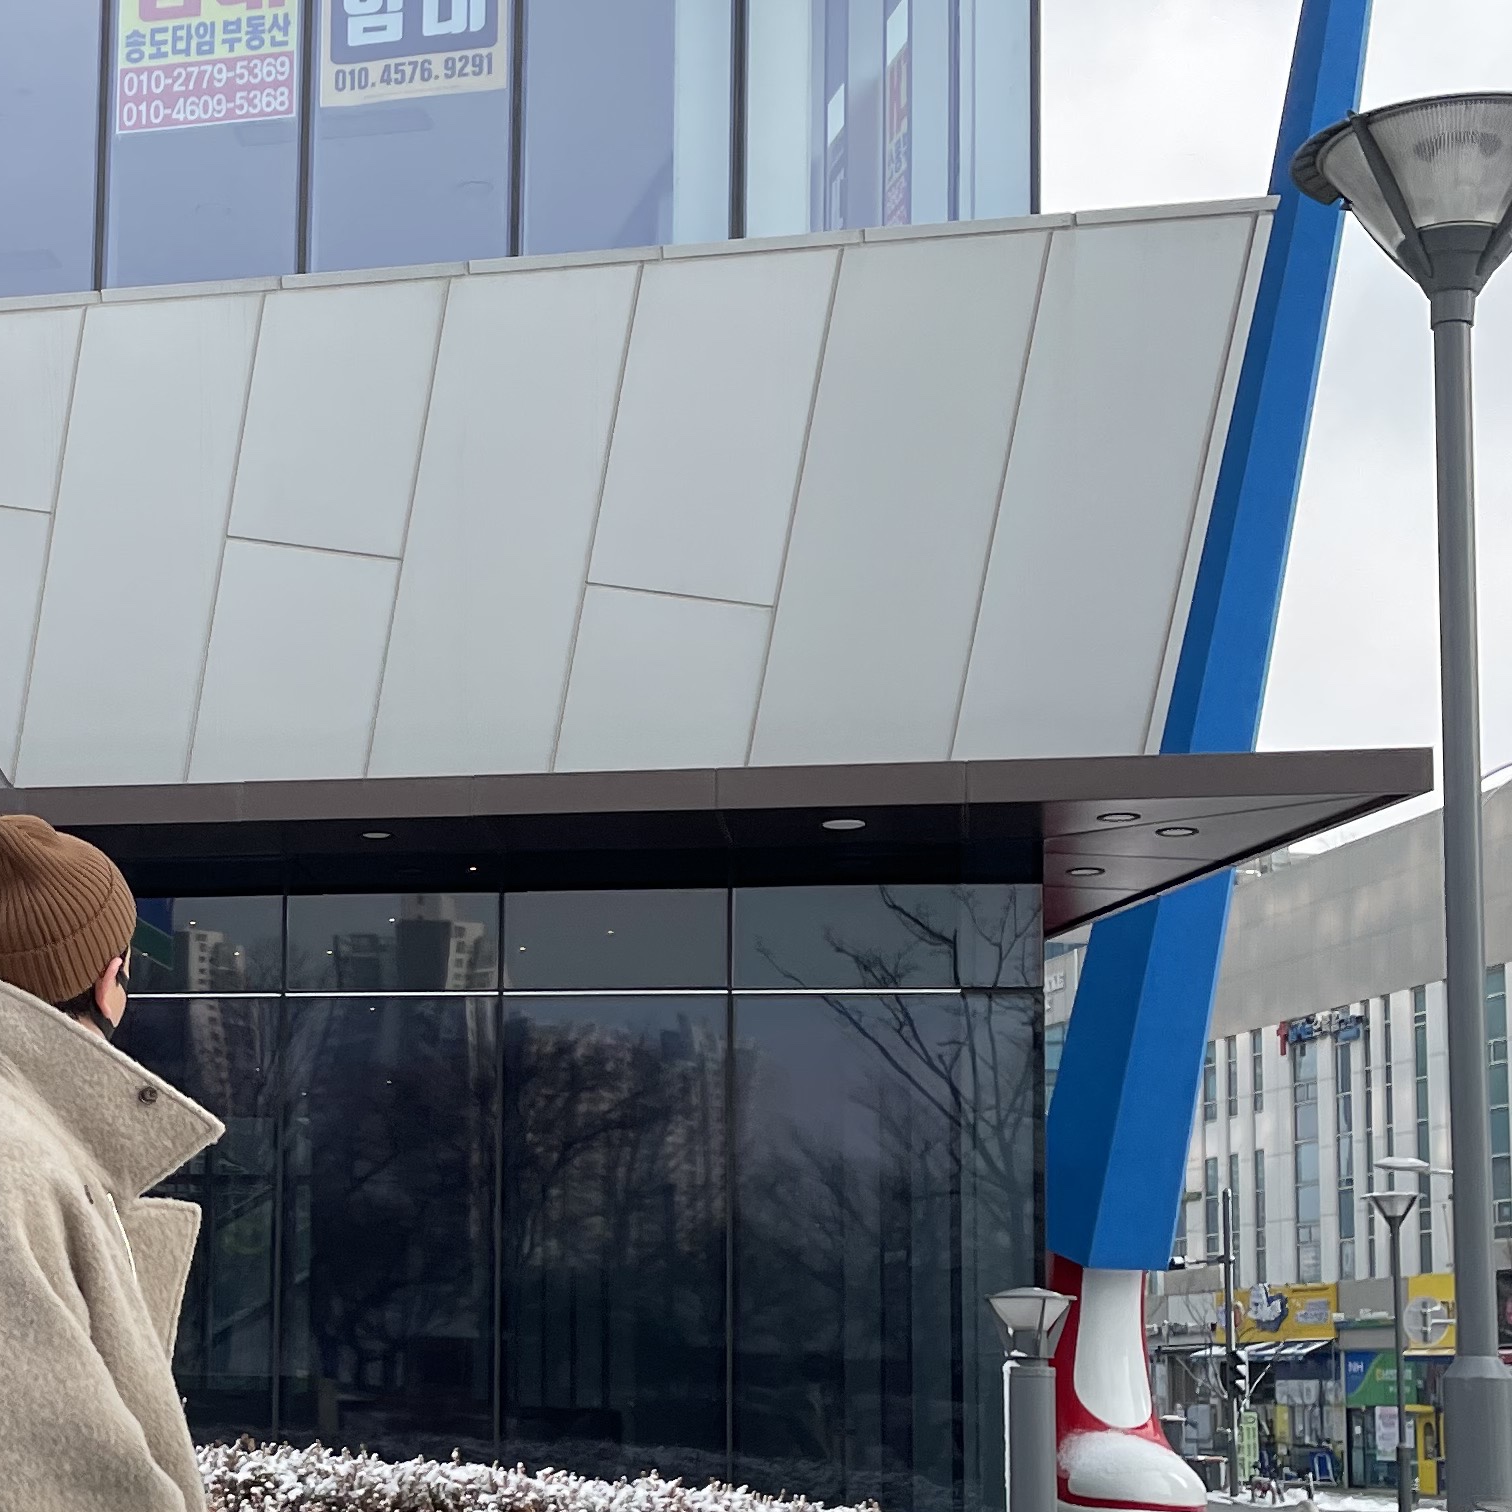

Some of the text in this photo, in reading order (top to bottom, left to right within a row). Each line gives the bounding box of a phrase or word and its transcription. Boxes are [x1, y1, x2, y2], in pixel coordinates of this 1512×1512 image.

[124, 12, 292, 64] 송도타임 부동산
[123, 56, 291, 97] 010-2779-5369
[334, 52, 493, 92] 010.4576.9291
[122, 86, 290, 127] 010-4609-5368
